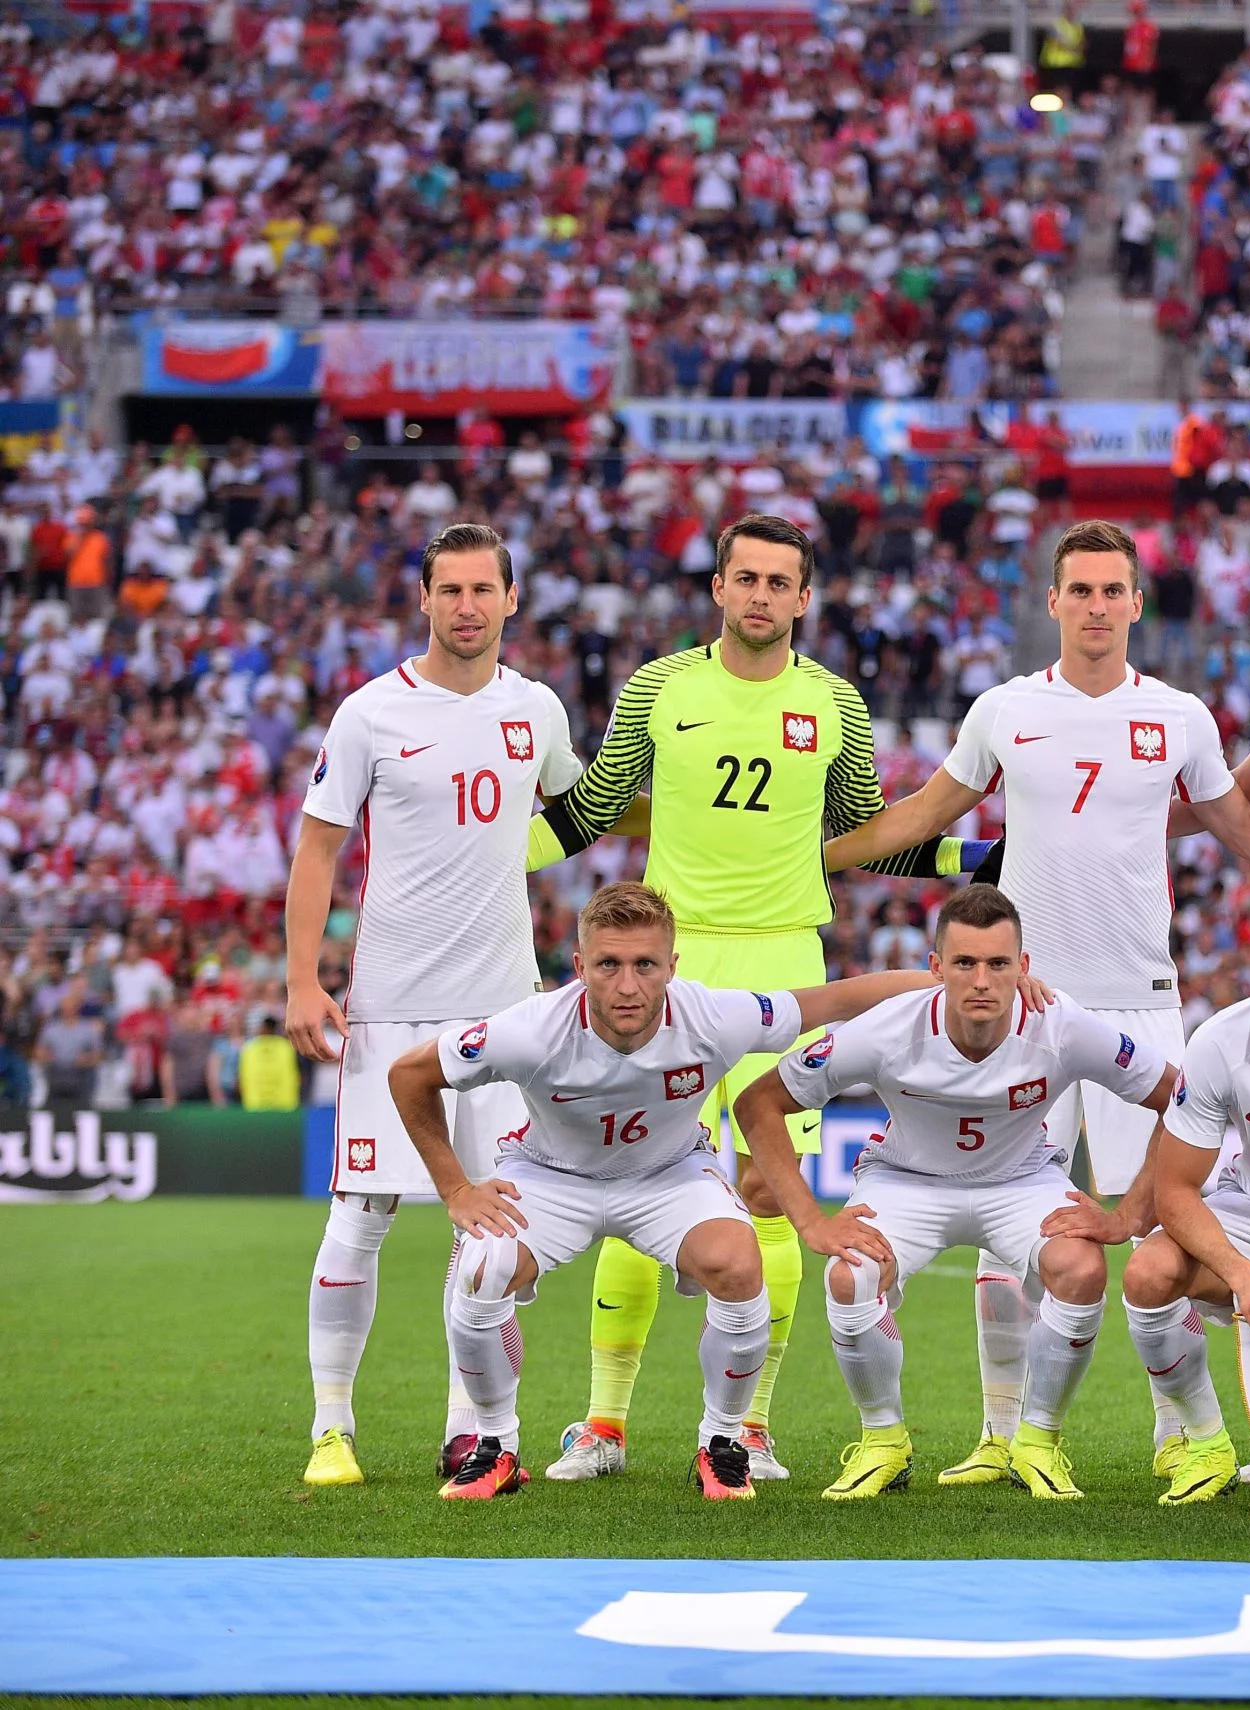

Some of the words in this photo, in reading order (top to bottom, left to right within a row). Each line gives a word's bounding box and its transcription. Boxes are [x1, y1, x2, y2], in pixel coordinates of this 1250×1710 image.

[451, 769, 501, 826] 10
[711, 755, 772, 812] 22
[1072, 761, 1102, 814] 7
[600, 1110, 649, 1146] 16
[956, 1117, 985, 1152] 5
